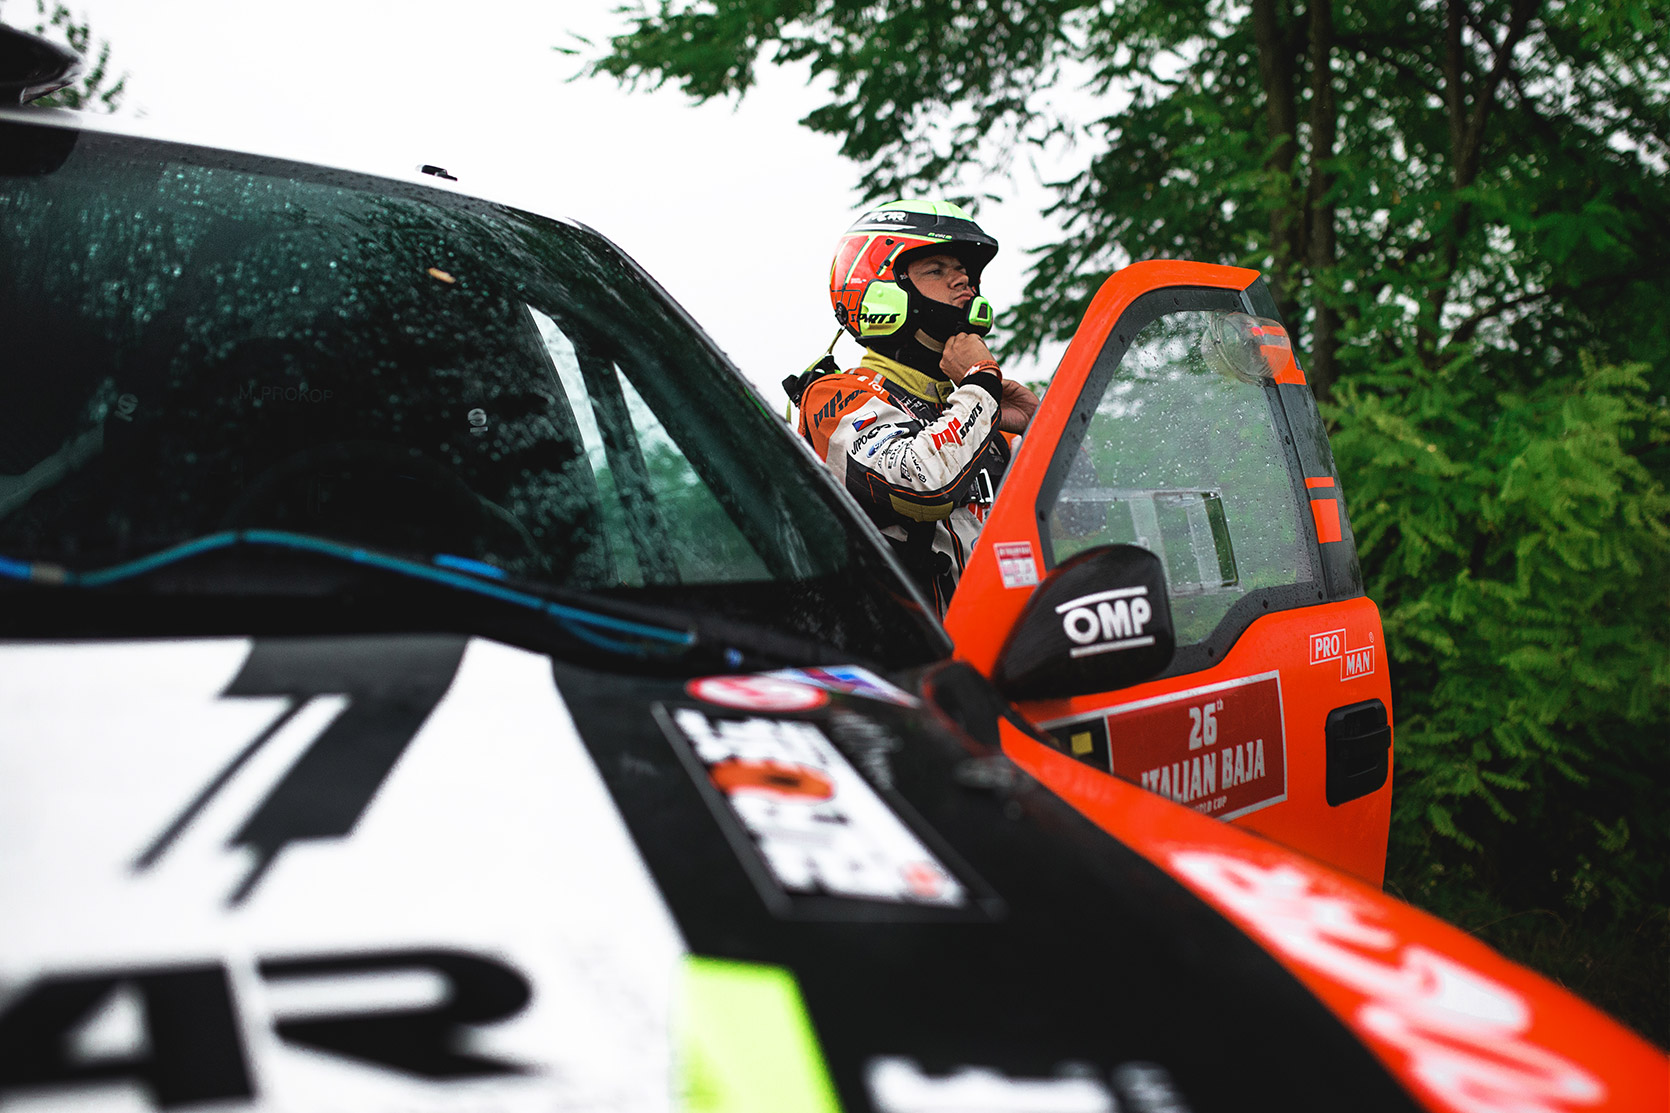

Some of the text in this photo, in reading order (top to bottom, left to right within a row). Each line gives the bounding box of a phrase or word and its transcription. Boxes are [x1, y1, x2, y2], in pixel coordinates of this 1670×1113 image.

[261, 387, 335, 404] PROKOP
[1063, 596, 1152, 645] OMP
[1315, 634, 1340, 660] PRO
[1346, 650, 1370, 676] MAN
[1221, 738, 1266, 790] BAJA
[1213, 795, 1228, 811] CUP
